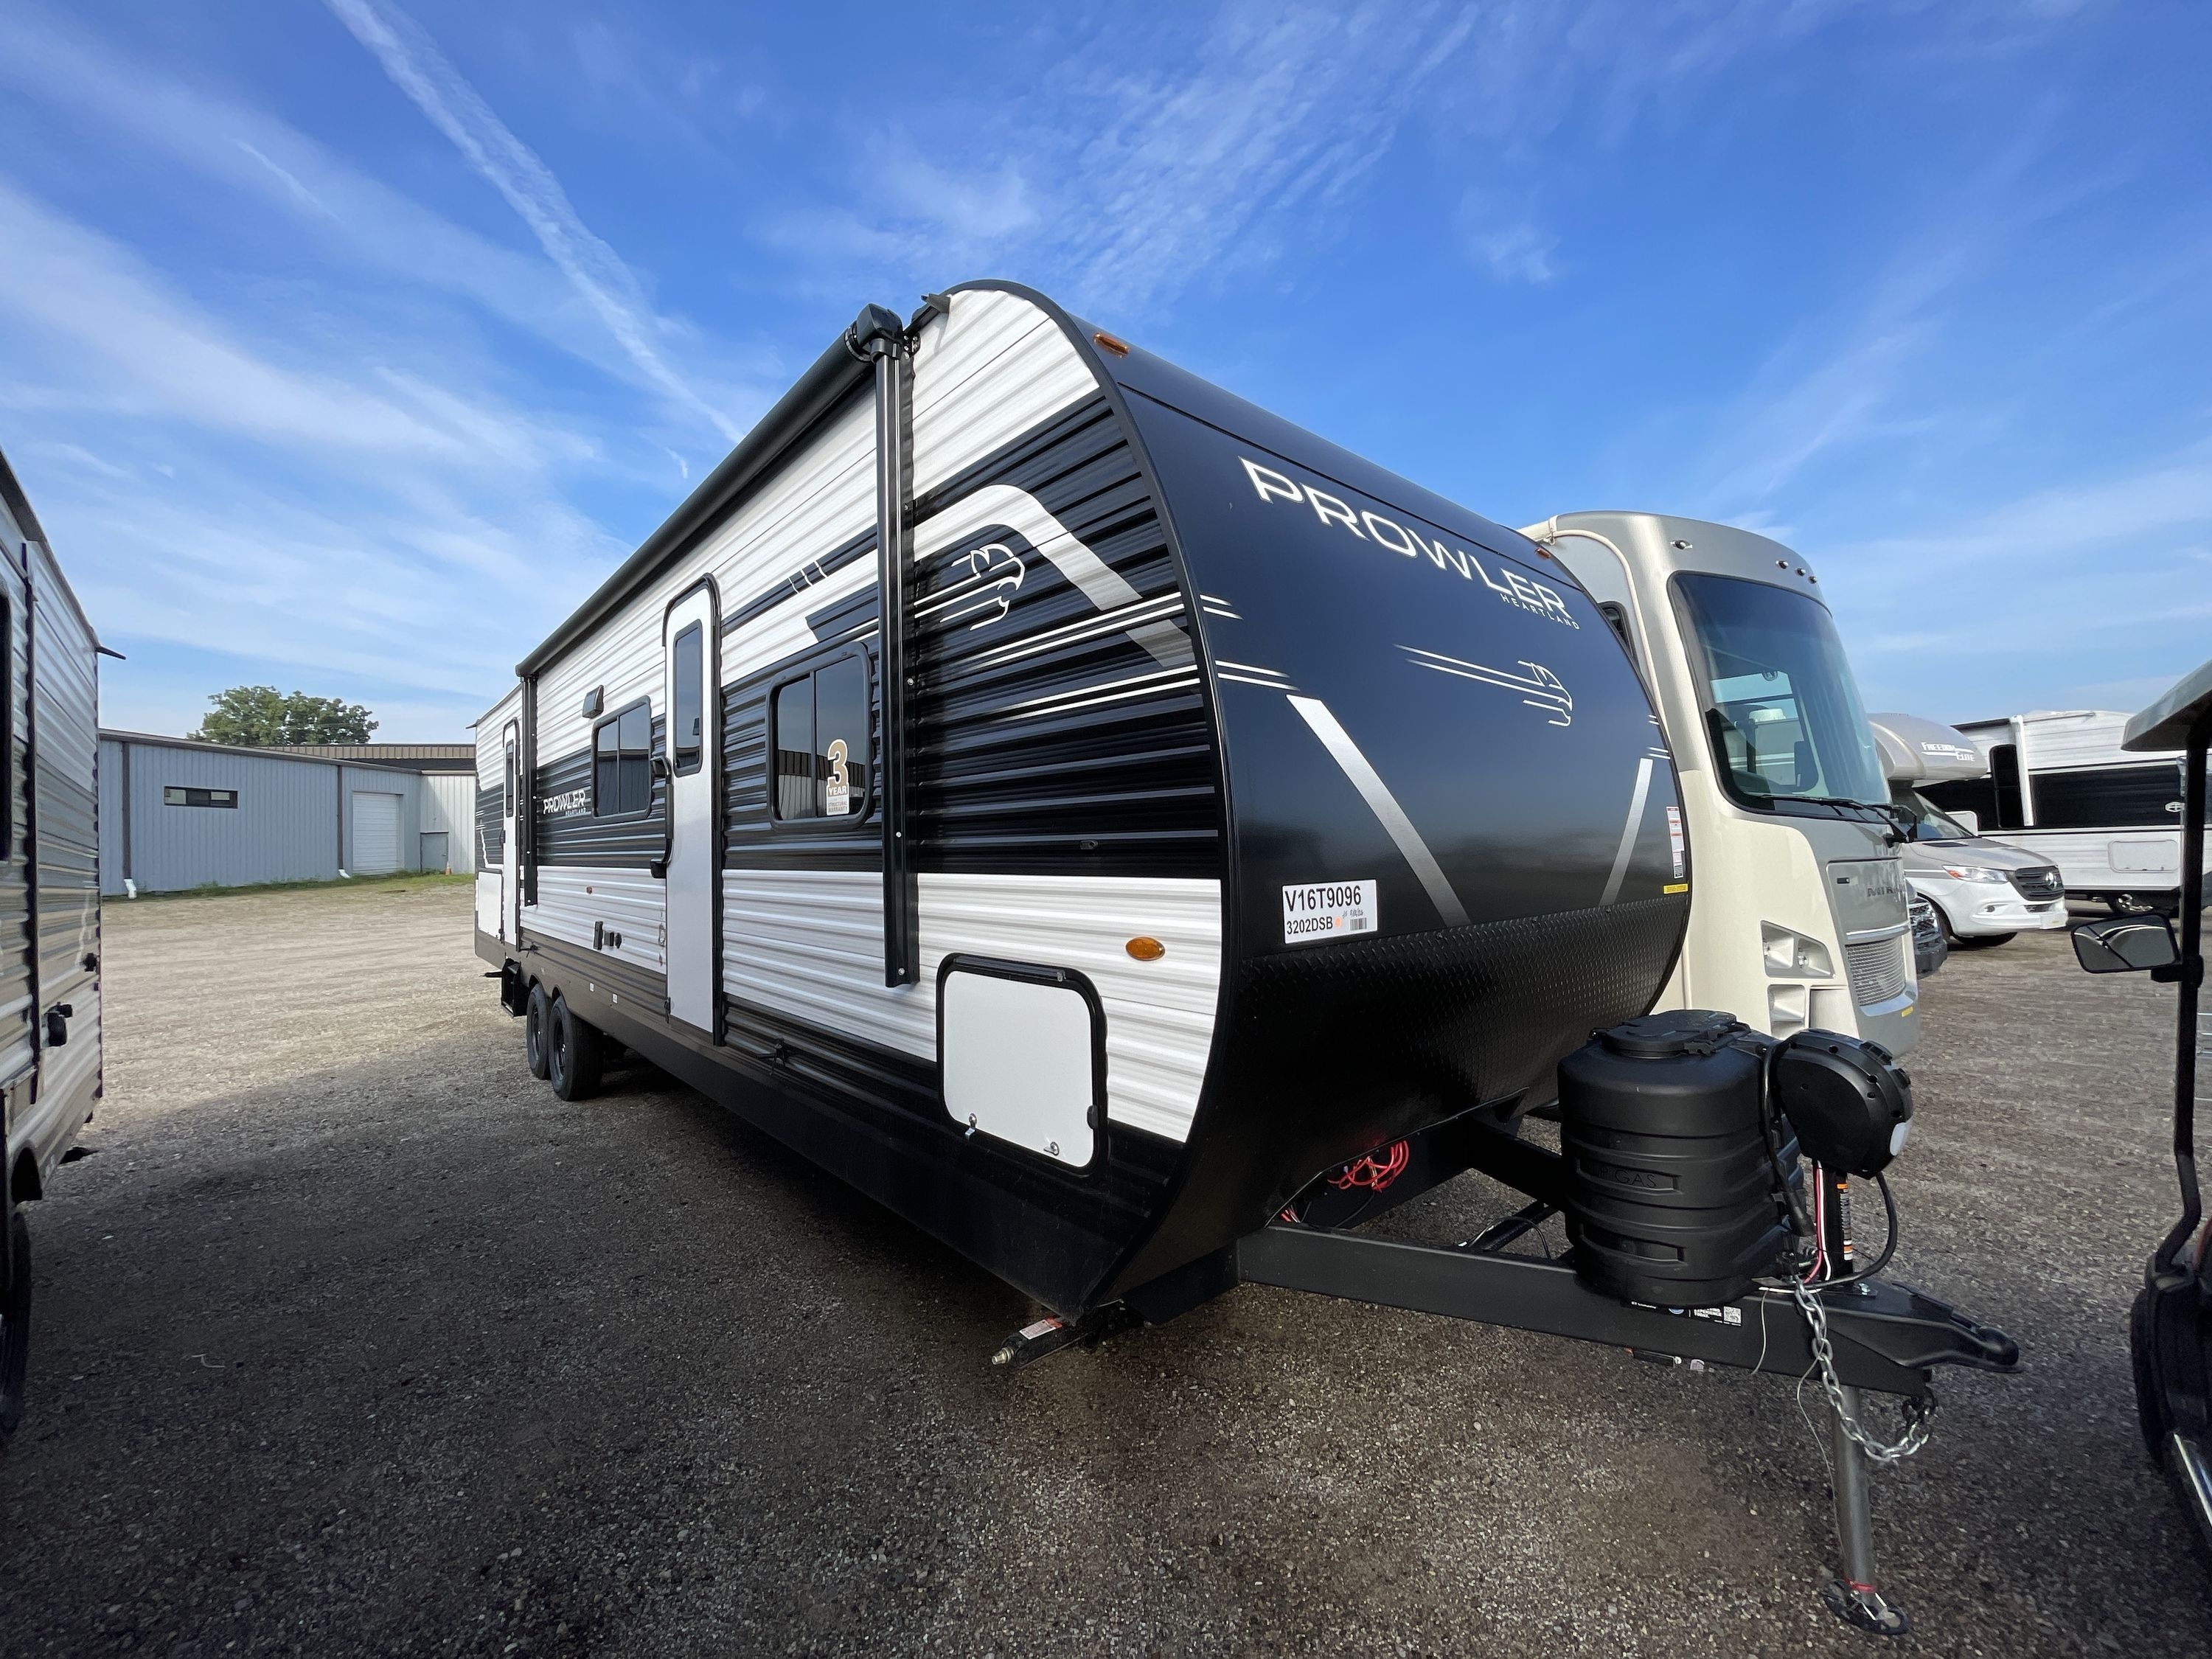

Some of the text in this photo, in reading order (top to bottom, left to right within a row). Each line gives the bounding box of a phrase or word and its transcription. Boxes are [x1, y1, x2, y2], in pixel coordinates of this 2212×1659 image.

[1238, 456, 1572, 619] PROWLER
[1499, 592, 1580, 630] HEARTLAND
[827, 739, 848, 786] 3
[543, 789, 586, 815] PROWLER
[828, 785, 847, 796] YEAR
[1284, 885, 1361, 912] V16T9096
[1287, 916, 1334, 935] 3202DSB
[1615, 1169, 1658, 1189] GAS
